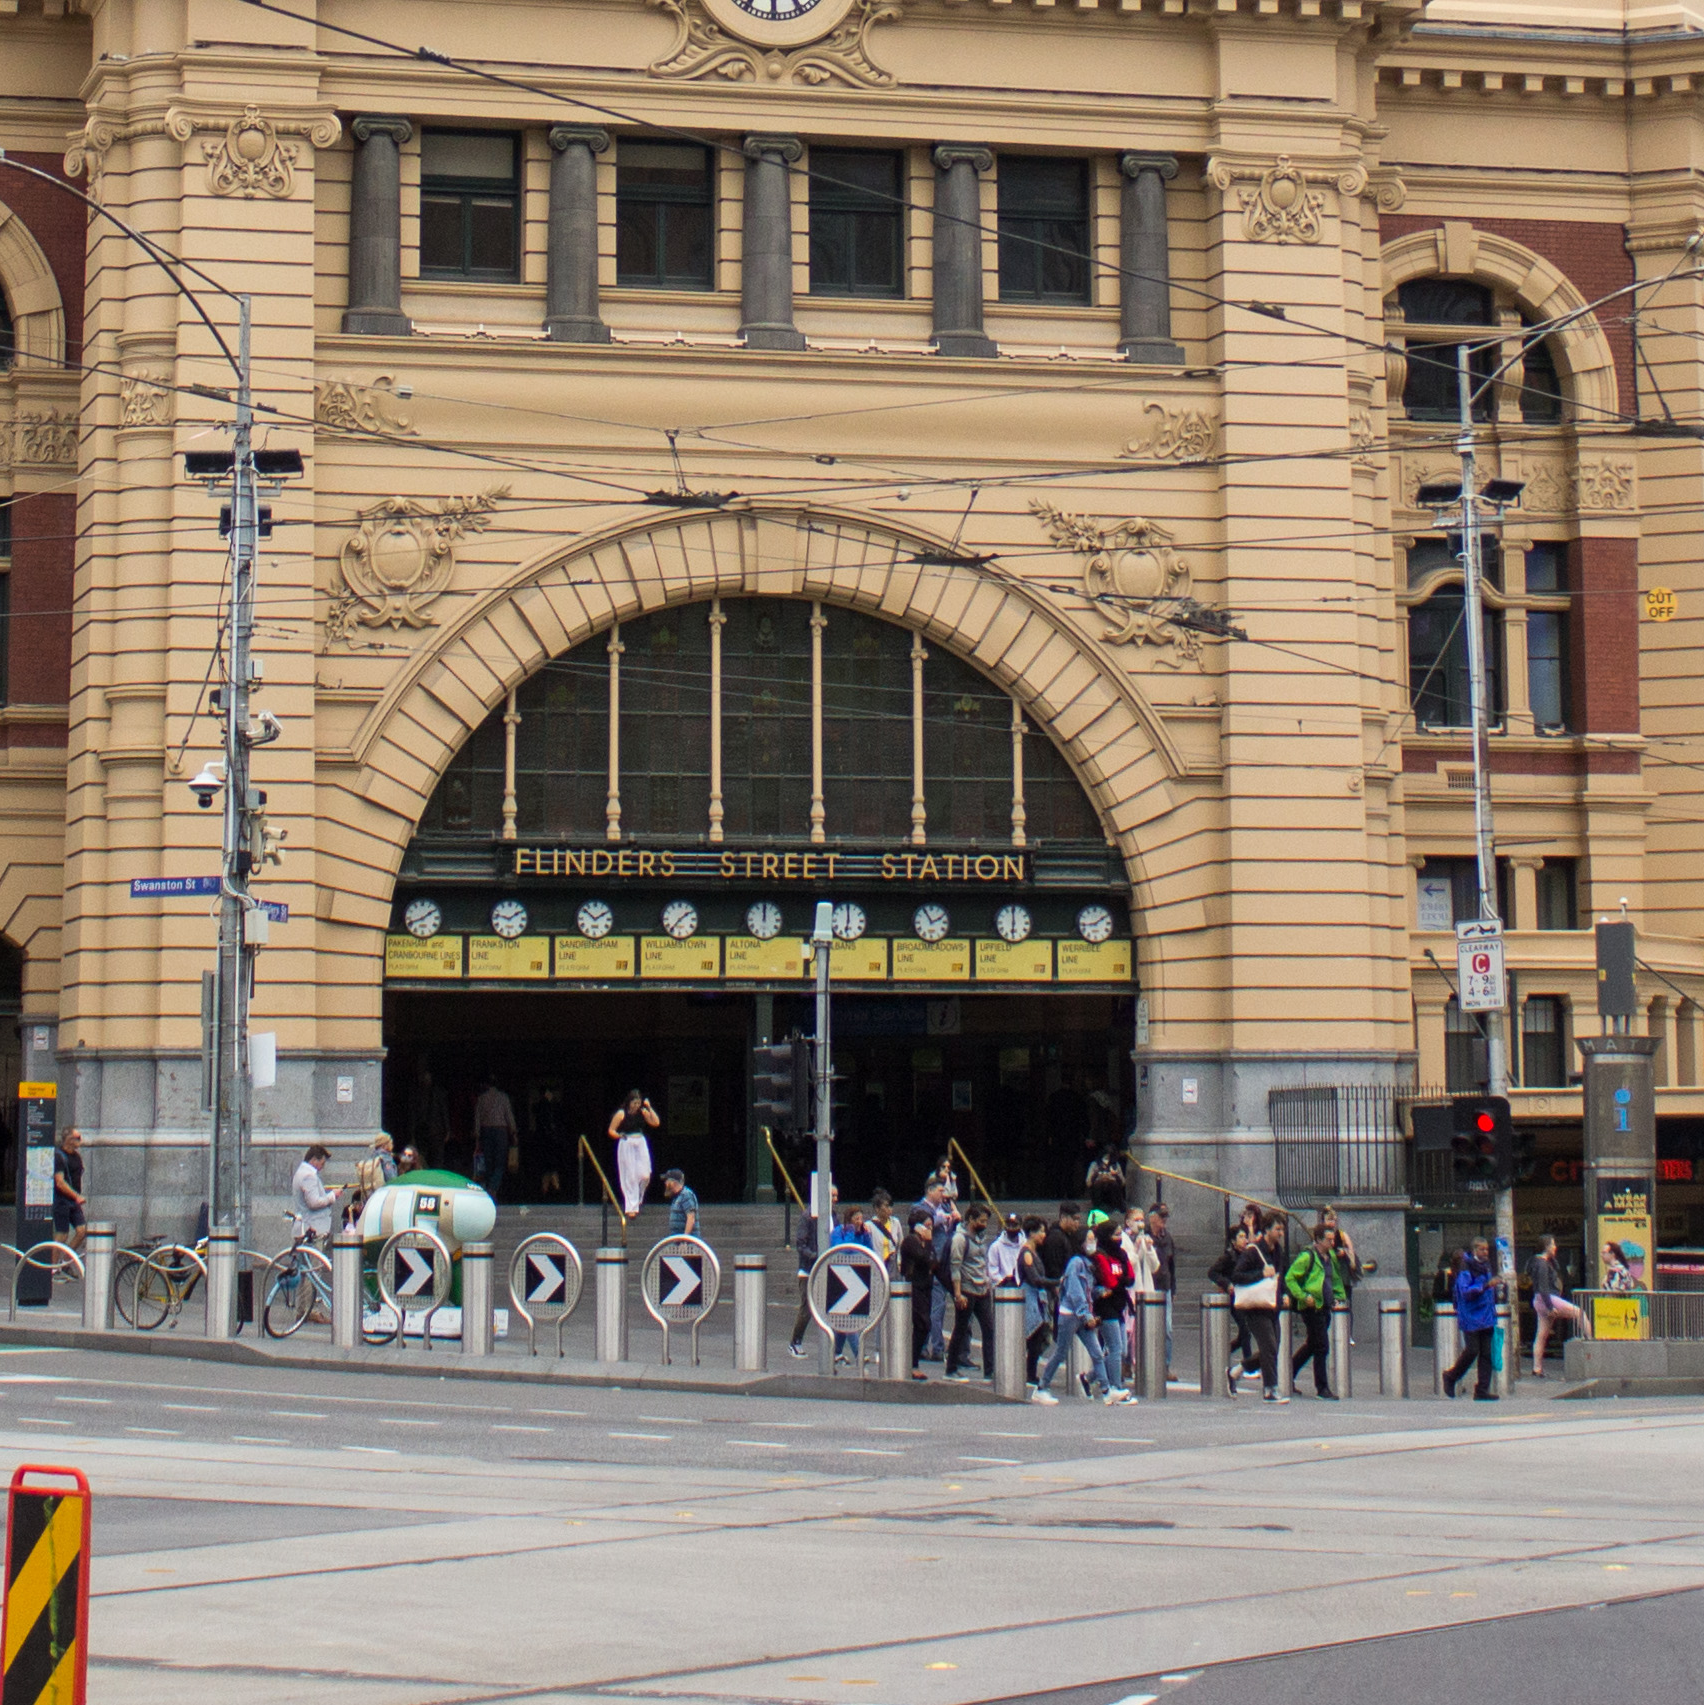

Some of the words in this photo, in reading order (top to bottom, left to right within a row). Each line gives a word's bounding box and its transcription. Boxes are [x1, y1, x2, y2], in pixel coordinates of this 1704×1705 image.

[1646, 593, 1672, 604] CUT
[1648, 607, 1674, 618] OFF
[516, 848, 675, 877] FLINDERS
[720, 851, 840, 879] STREET
[881, 853, 1024, 880] STATION
[133, 879, 183, 892] Swanston
[185, 878, 195, 890] St
[388, 939, 428, 947] PAKENHAM
[432, 940, 444, 948] and
[472, 940, 520, 949] FRANKSTON
[559, 941, 618, 949] SANDRINGHAM
[645, 941, 707, 949] WILLIAMSTOWN
[730, 940, 761, 948] ALTONA
[830, 942, 856, 951] LBANS
[897, 943, 965, 951] BROADMEADOWS
[980, 943, 1012, 952] UPFIELD
[1459, 943, 1500, 954] CLEARWAY
[388, 951, 438, 960] CRANBOURNE
[440, 951, 460, 961] LINES
[472, 952, 489, 960] LINE
[559, 952, 576, 960] LINE
[645, 952, 663, 960] LINE
[730, 951, 747, 960] LINE
[897, 954, 914, 963] LINE
[980, 955, 997, 963] LINE
[1062, 955, 1078, 963] LINE
[1475, 955, 1487, 973] C
